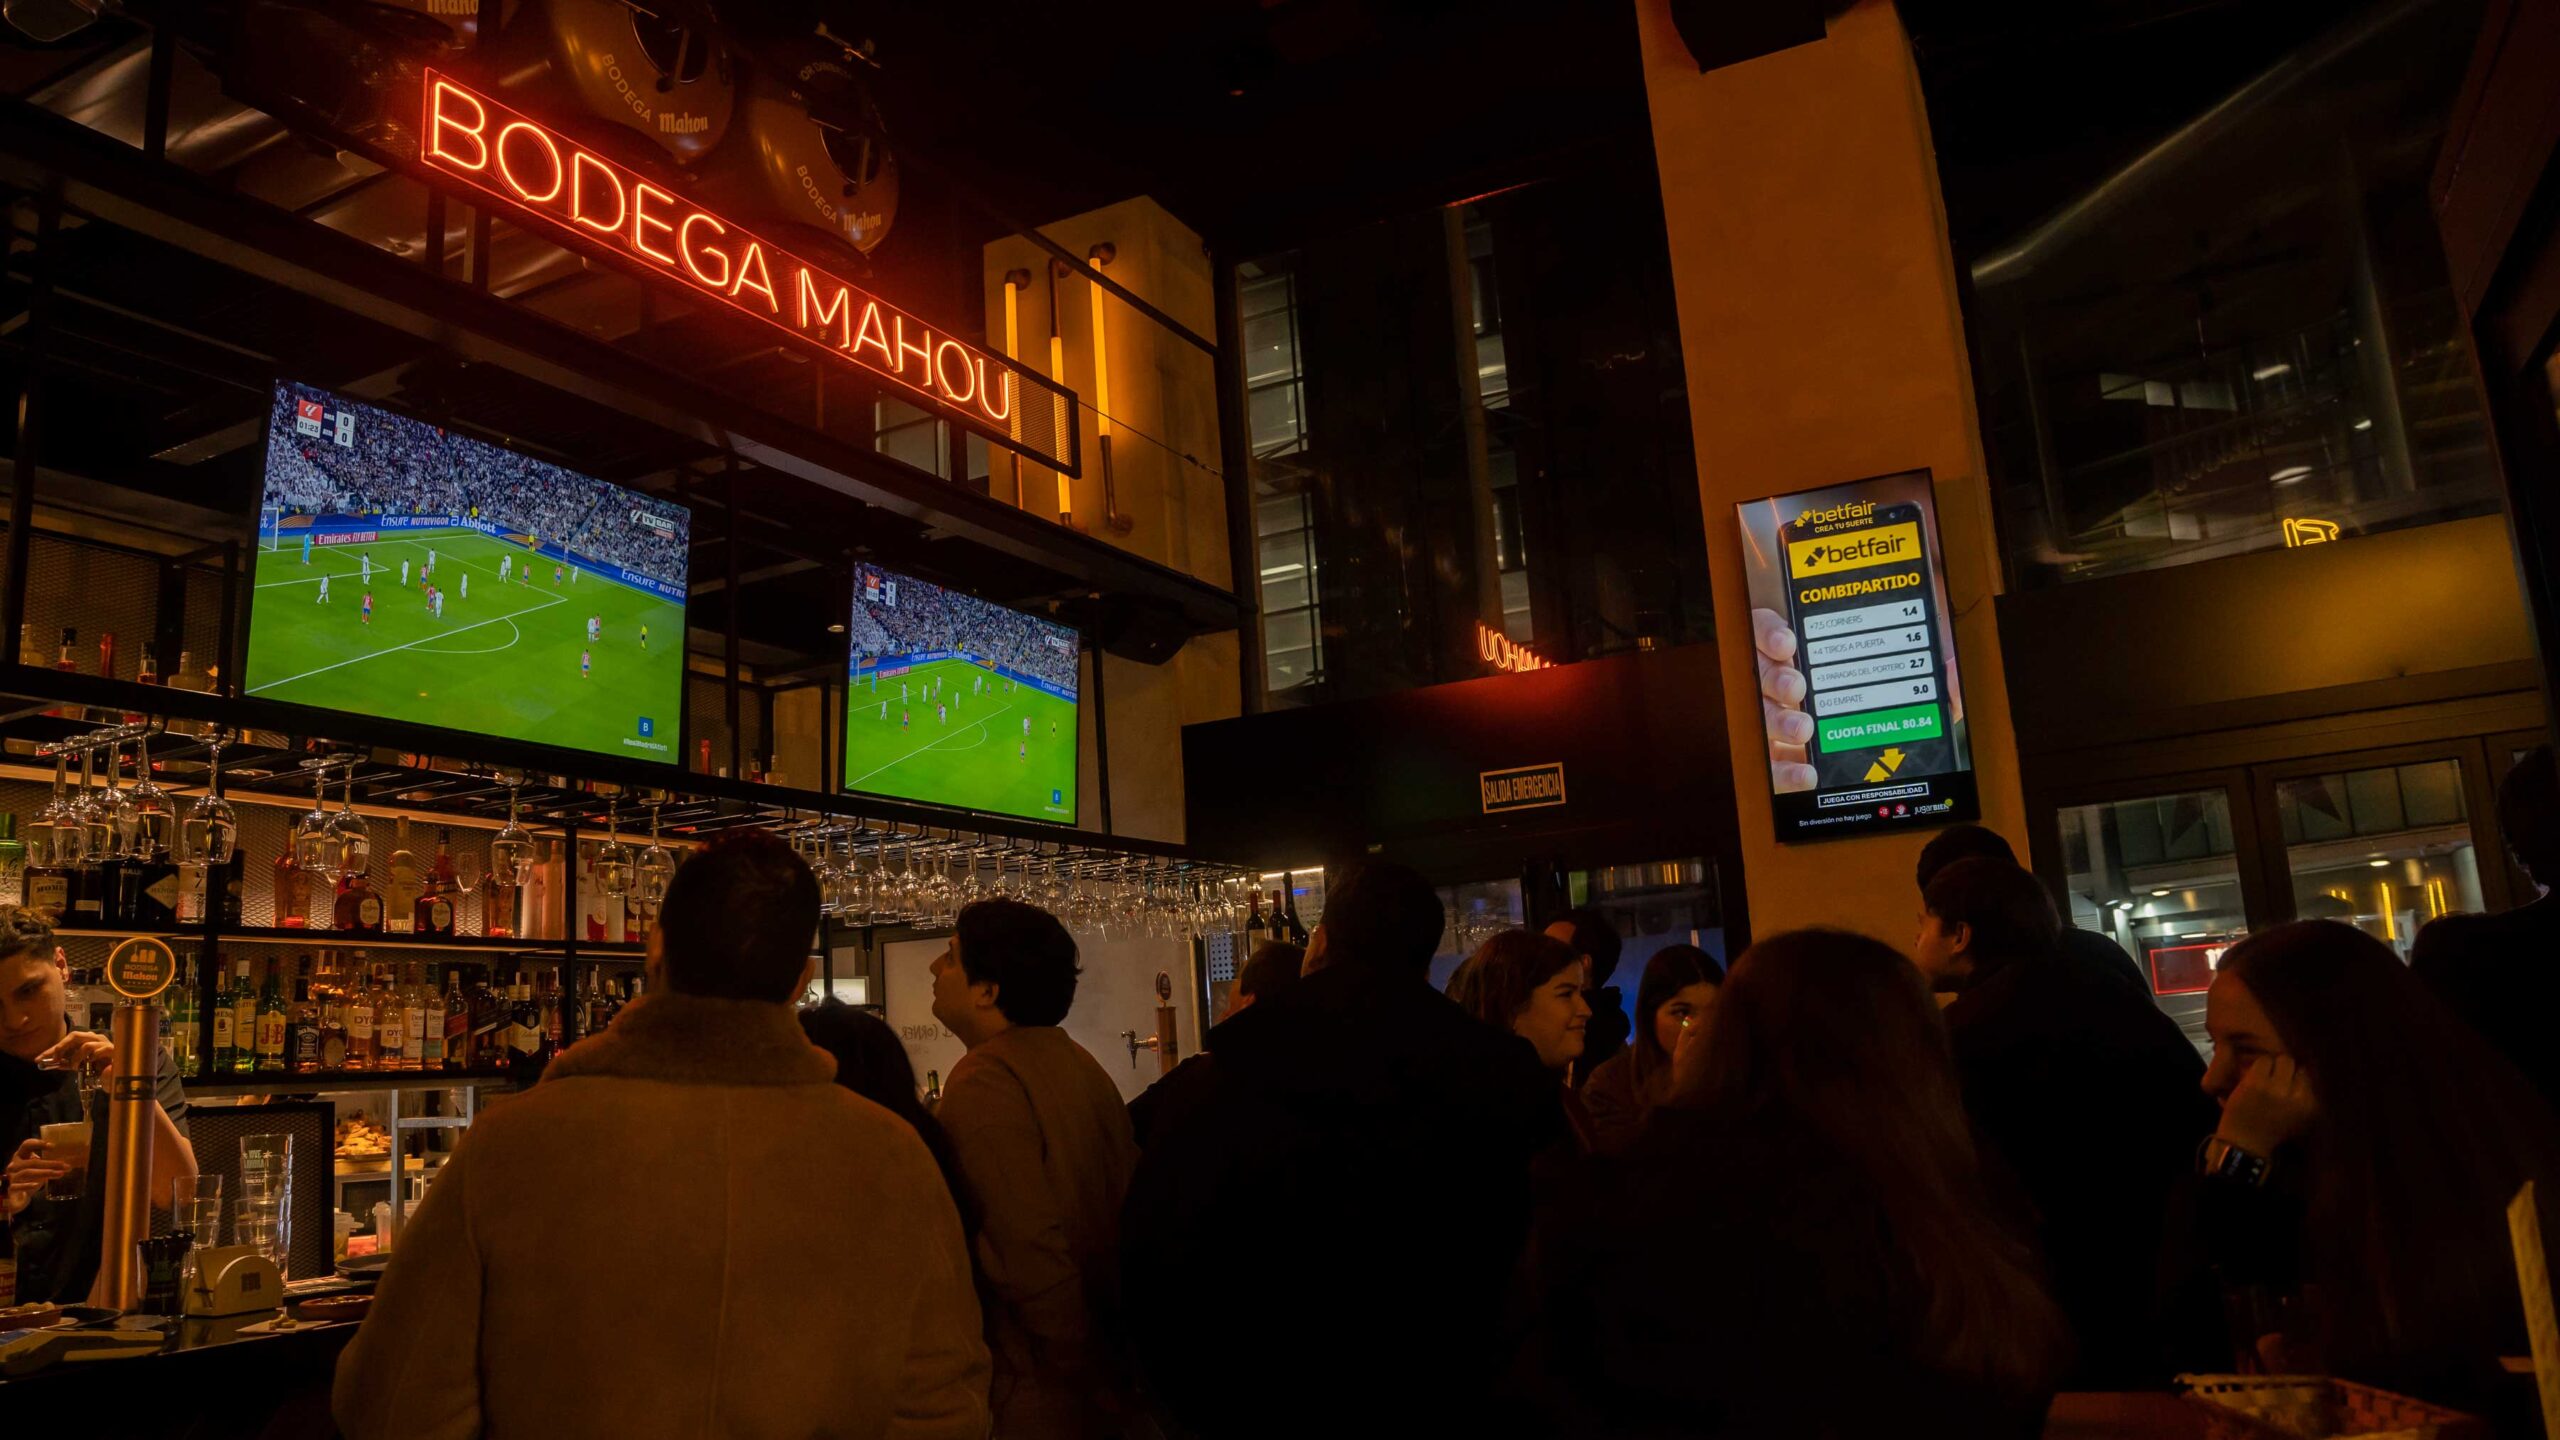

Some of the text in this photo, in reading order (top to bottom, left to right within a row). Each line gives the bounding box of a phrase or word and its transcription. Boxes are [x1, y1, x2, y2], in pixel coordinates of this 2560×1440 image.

[602, 53, 652, 123] BODEGA
[659, 111, 709, 135] Mahou
[796, 164, 838, 225] BODEGA
[842, 212, 882, 232] Mahou
[431, 79, 1010, 421] BODEGA MAHOU
[299, 421, 319, 433] 01:23
[343, 416, 349, 427] 0
[341, 432, 348, 443] 0
[381, 513, 450, 527] Ensure NUTRIVIGOR
[1812, 500, 1877, 524] betfair
[460, 515, 497, 534] Abbott
[656, 518, 672, 531] BAR
[1814, 517, 1874, 534] CREA TU SUERTE
[318, 532, 351, 546] Emirates
[1827, 534, 1907, 564] betfair
[621, 568, 656, 589] Ensure
[1800, 572, 1921, 604] COMBIPARTIDO
[1902, 606, 1918, 617] 1.4
[1825, 614, 1863, 630] CORNERS
[1824, 644, 1848, 655] TIROS
[1848, 643, 1854, 651] A
[1855, 637, 1886, 650] PUERTA
[1906, 632, 1922, 643] 1.6
[1826, 668, 1858, 681] PARADAS
[1858, 667, 1870, 677] DEL
[1871, 662, 1906, 674] PORTERO
[1910, 658, 1925, 669] 2.7
[1912, 684, 1929, 695] 9.0
[1833, 694, 1864, 707] EMPATE
[1826, 715, 1933, 741] CUOTA FINAL 80.84
[1485, 772, 1561, 805] SALIDA EMERGENCIA
[1822, 786, 1924, 805] JUEGA CON RESPONSABILIDAD
[1798, 812, 1873, 828] Sin diversión no hay juego
[122, 970, 158, 981] Mahou
[124, 963, 159, 972] BODEGA
